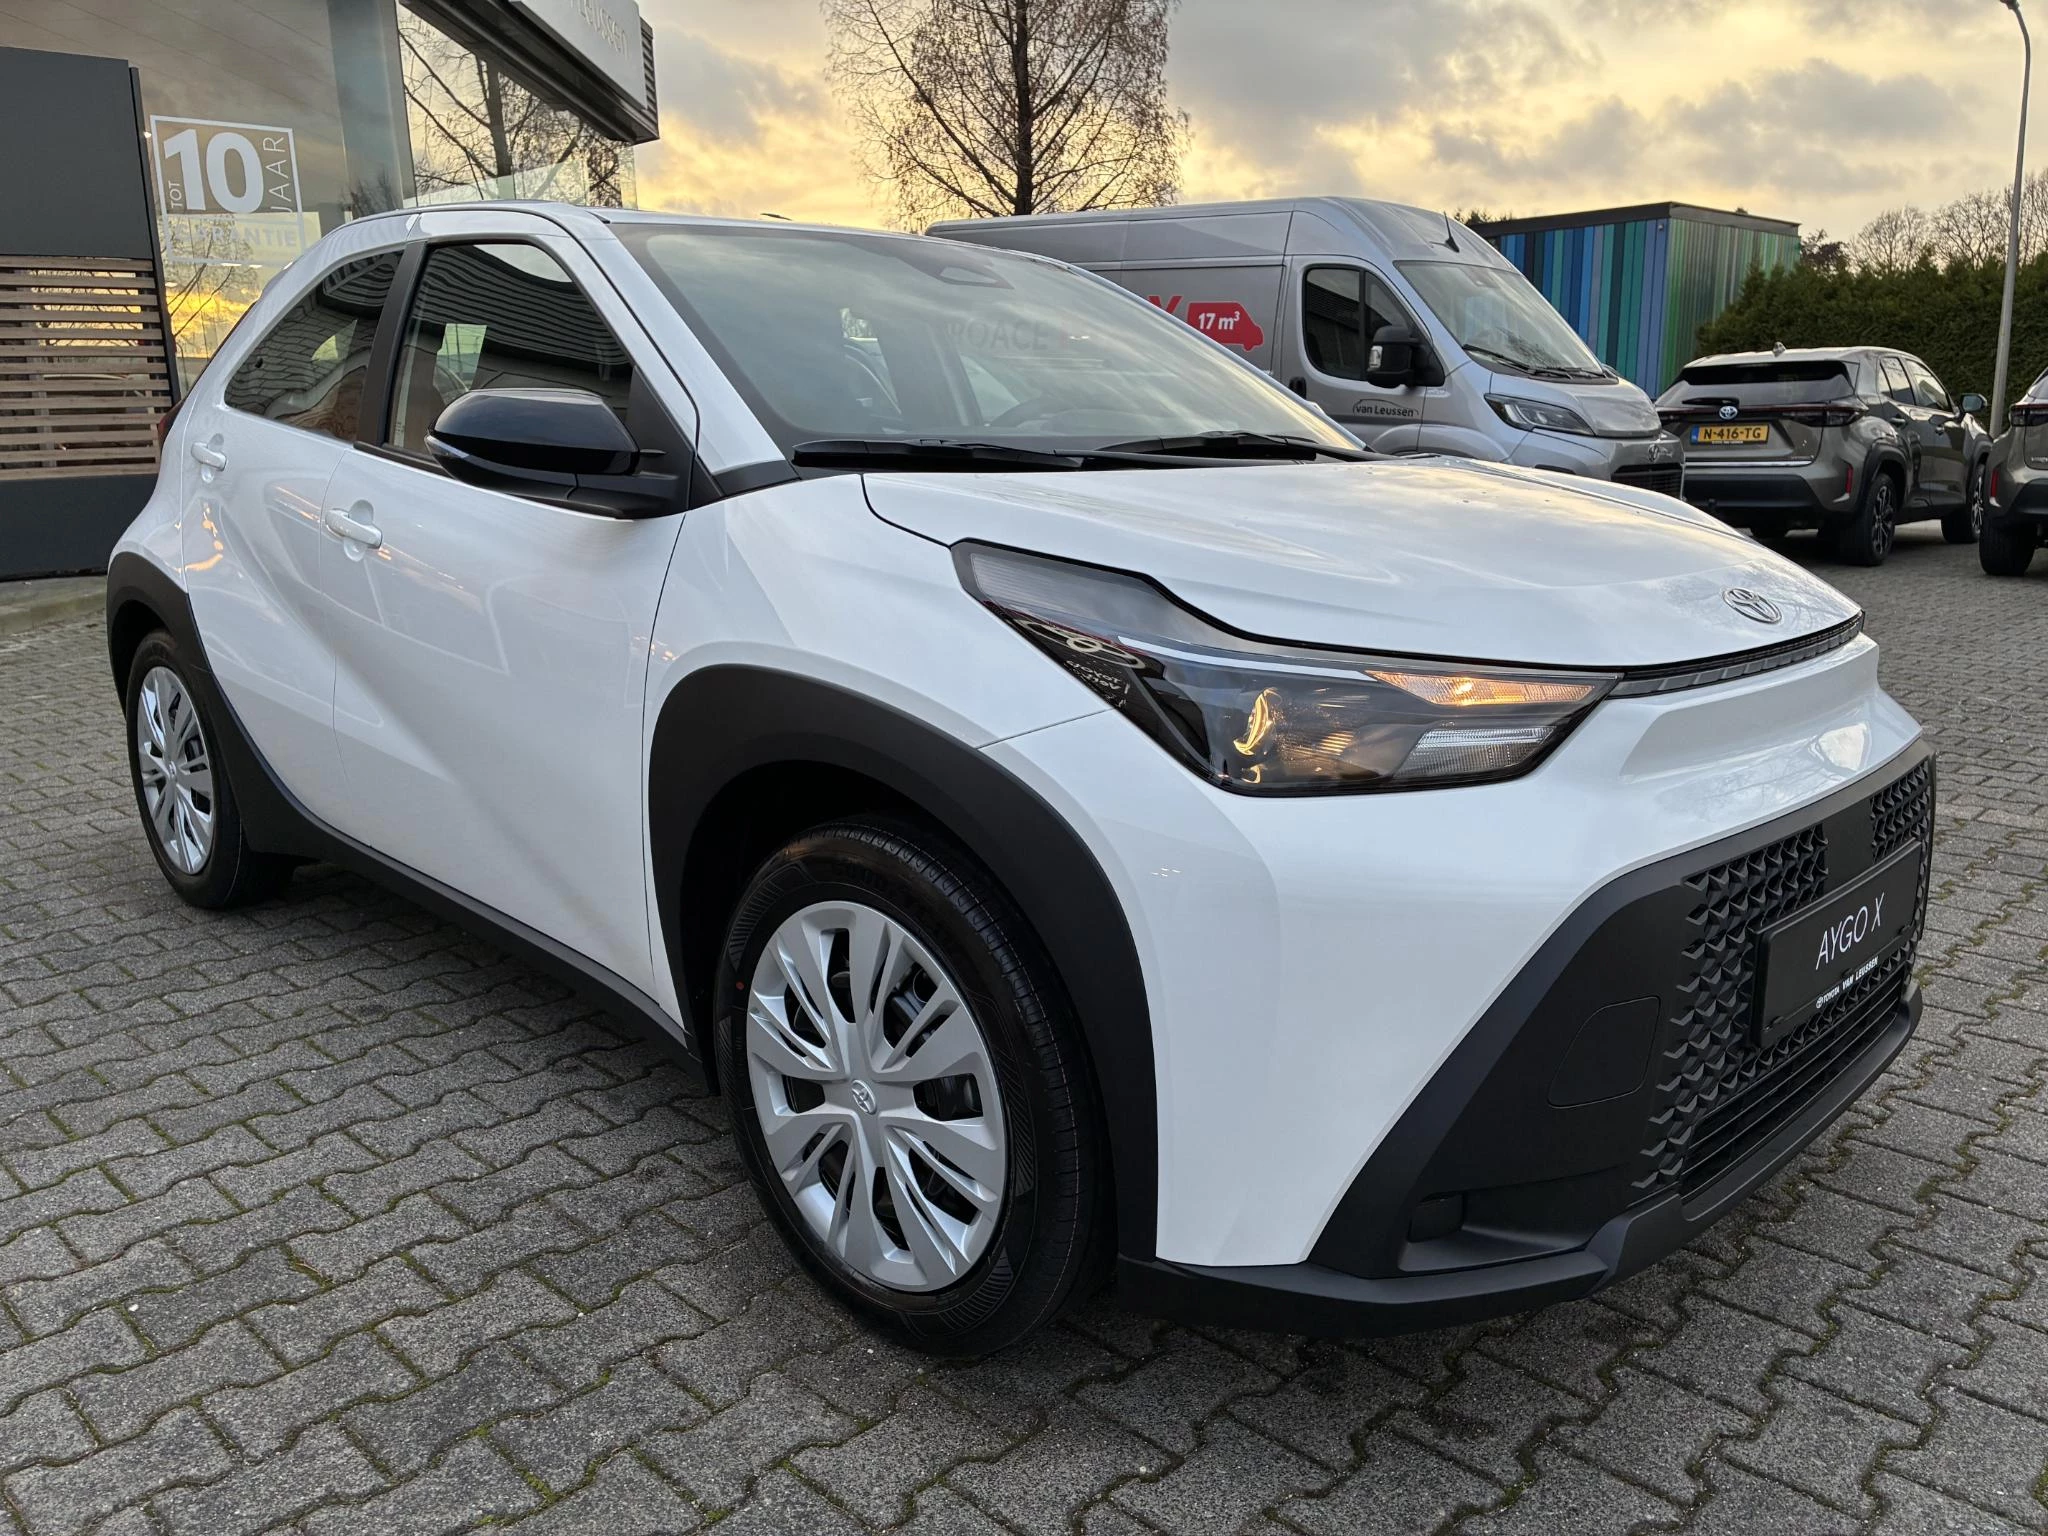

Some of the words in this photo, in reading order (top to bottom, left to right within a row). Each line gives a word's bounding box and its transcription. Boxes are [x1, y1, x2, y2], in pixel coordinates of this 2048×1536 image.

[163, 128, 264, 213] 10
[262, 136, 293, 213] JAAR
[168, 180, 183, 209] TOT
[1198, 312, 1216, 330] 17
[1355, 405, 1373, 414] van
[1374, 404, 1414, 417] Leussen
[1703, 427, 1762, 440] N-416-TG
[1815, 905, 1869, 971] AYGO
[1870, 891, 1885, 932] X
[1822, 985, 1840, 1004] TOYOTA
[1842, 974, 1855, 991] VAN
[1855, 956, 1879, 980] LEUSSEN
